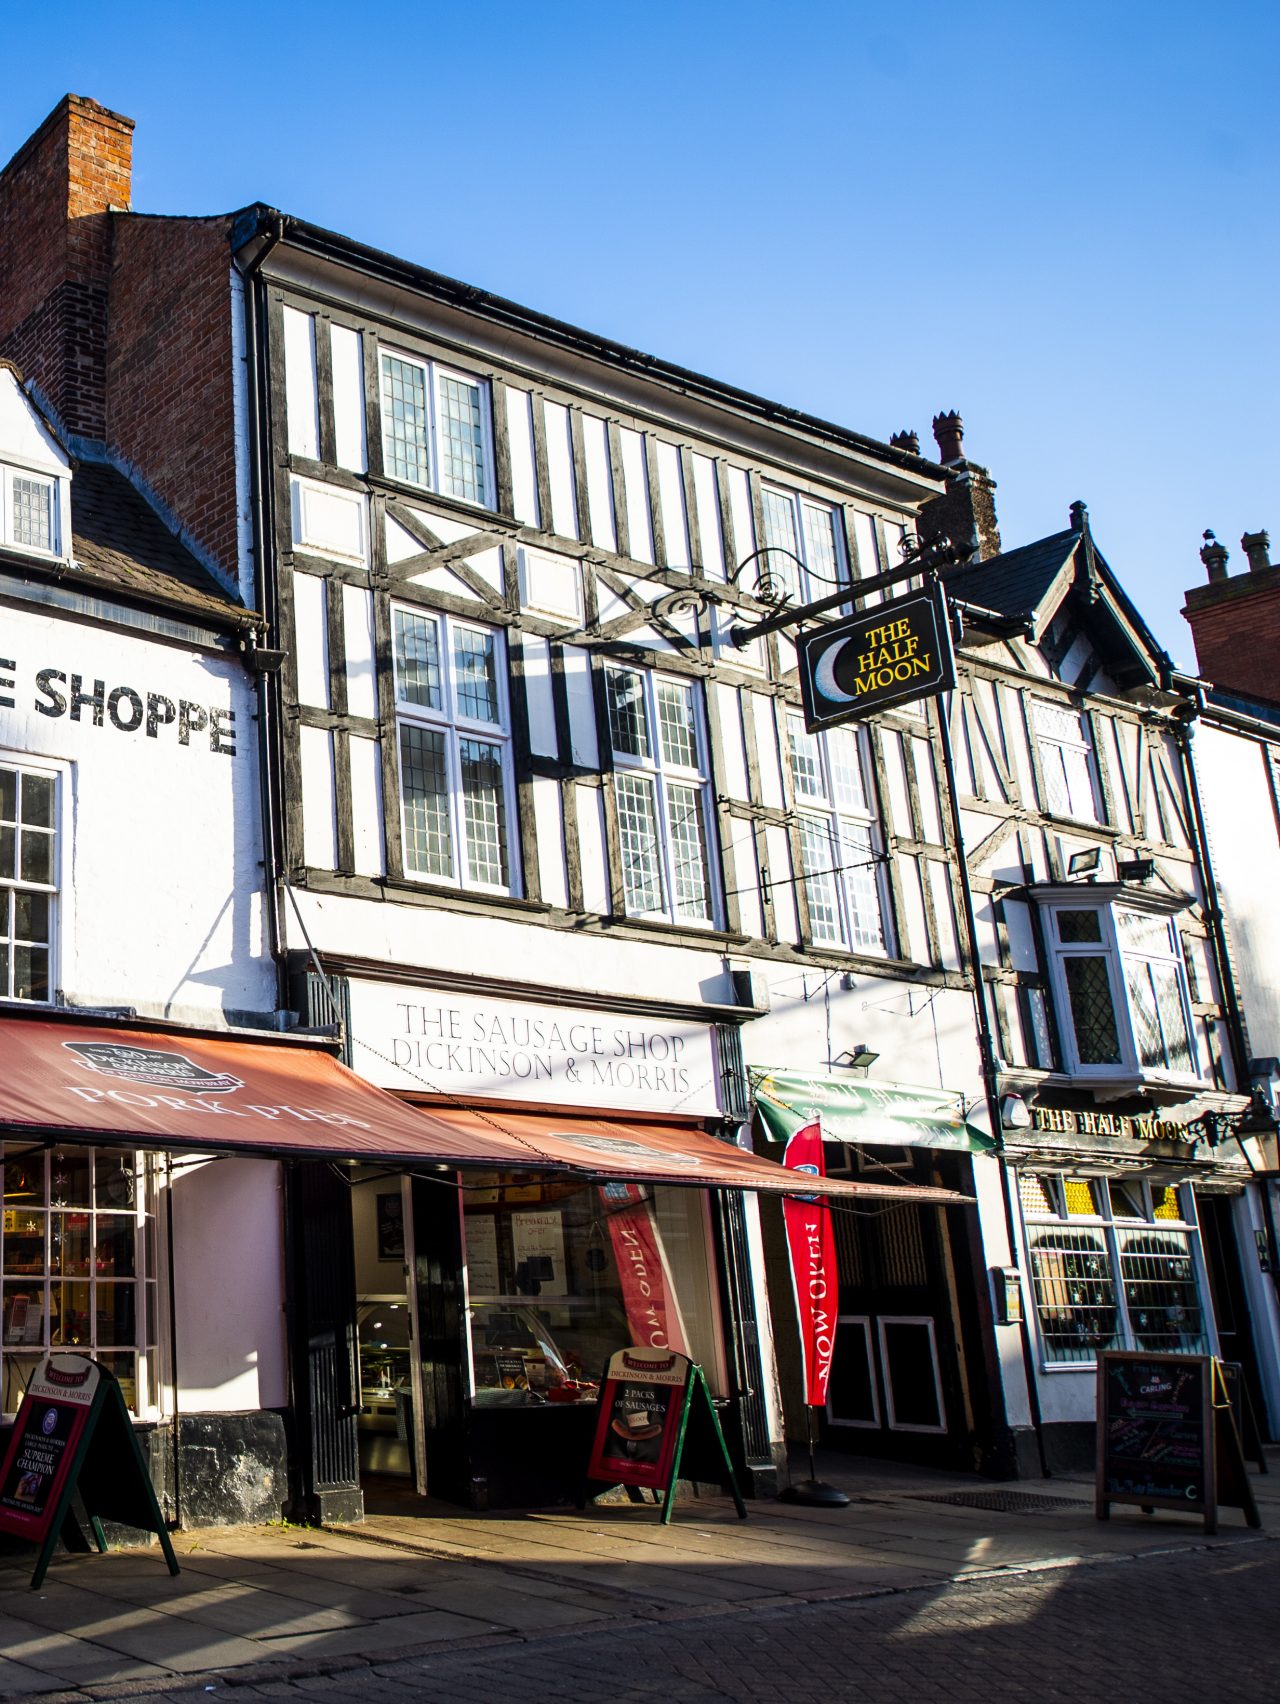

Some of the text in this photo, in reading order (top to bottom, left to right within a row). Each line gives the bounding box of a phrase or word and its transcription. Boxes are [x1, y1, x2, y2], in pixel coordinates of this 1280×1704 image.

[865, 617, 911, 648] THE
[857, 636, 919, 673] HALF
[853, 653, 931, 695] MOON
[34, 668, 237, 757] SHOPPE
[397, 1003, 685, 1062] THE SAUSAGE SHOP
[391, 1038, 690, 1093] DICKINSON & MORRIS
[62, 1086, 372, 1128] PORK PIES
[1036, 1108, 1190, 1143] THE HALF MOON
[809, 1306, 831, 1381] NOW
[611, 1370, 648, 1380] DICKINSON
[656, 1373, 682, 1382] MORRIS
[628, 1359, 657, 1369] WELCOME
[48, 1371, 84, 1383] WELCOME TO
[1140, 1382, 1173, 1394] CARLING
[31, 1383, 63, 1396] DICKINSON
[68, 1390, 92, 1401] MORRIS
[625, 1389, 656, 1399] 2 PACKS
[615, 1400, 667, 1413] OF SAUSAGES
[17, 1457, 55, 1475] CHAMPION
[24, 1448, 55, 1464] SUPREME
